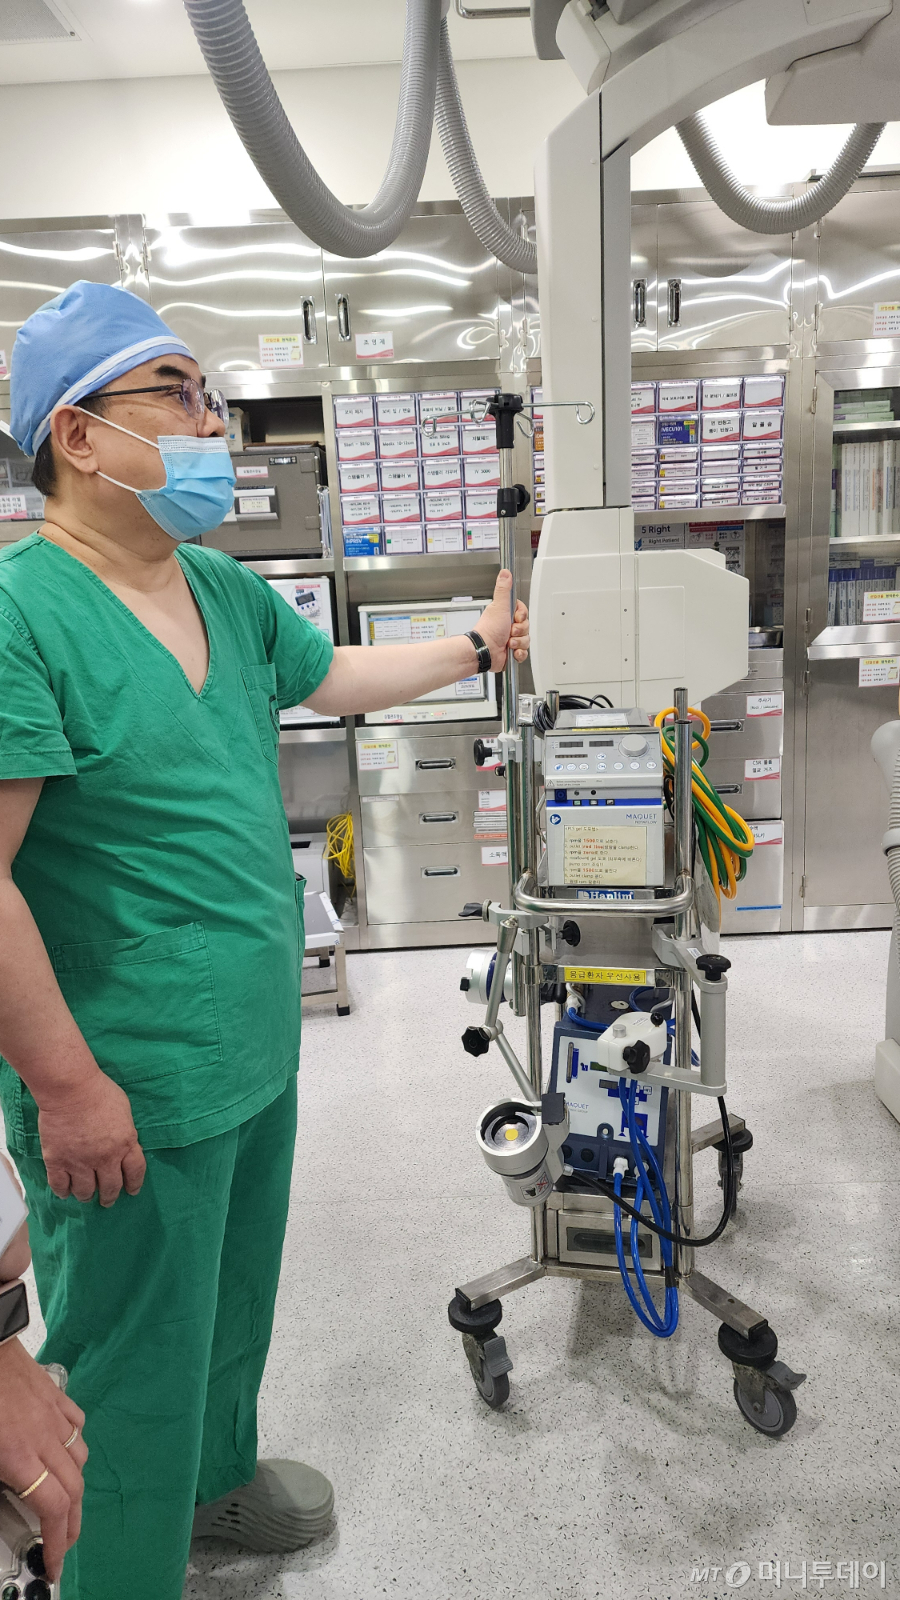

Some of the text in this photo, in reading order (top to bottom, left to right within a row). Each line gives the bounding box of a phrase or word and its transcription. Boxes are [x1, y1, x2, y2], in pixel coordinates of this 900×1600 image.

[648, 525, 671, 534] Right
[590, 891, 632, 900] Hanlim
[570, 970, 641, 982] 응급환자 우선사용
